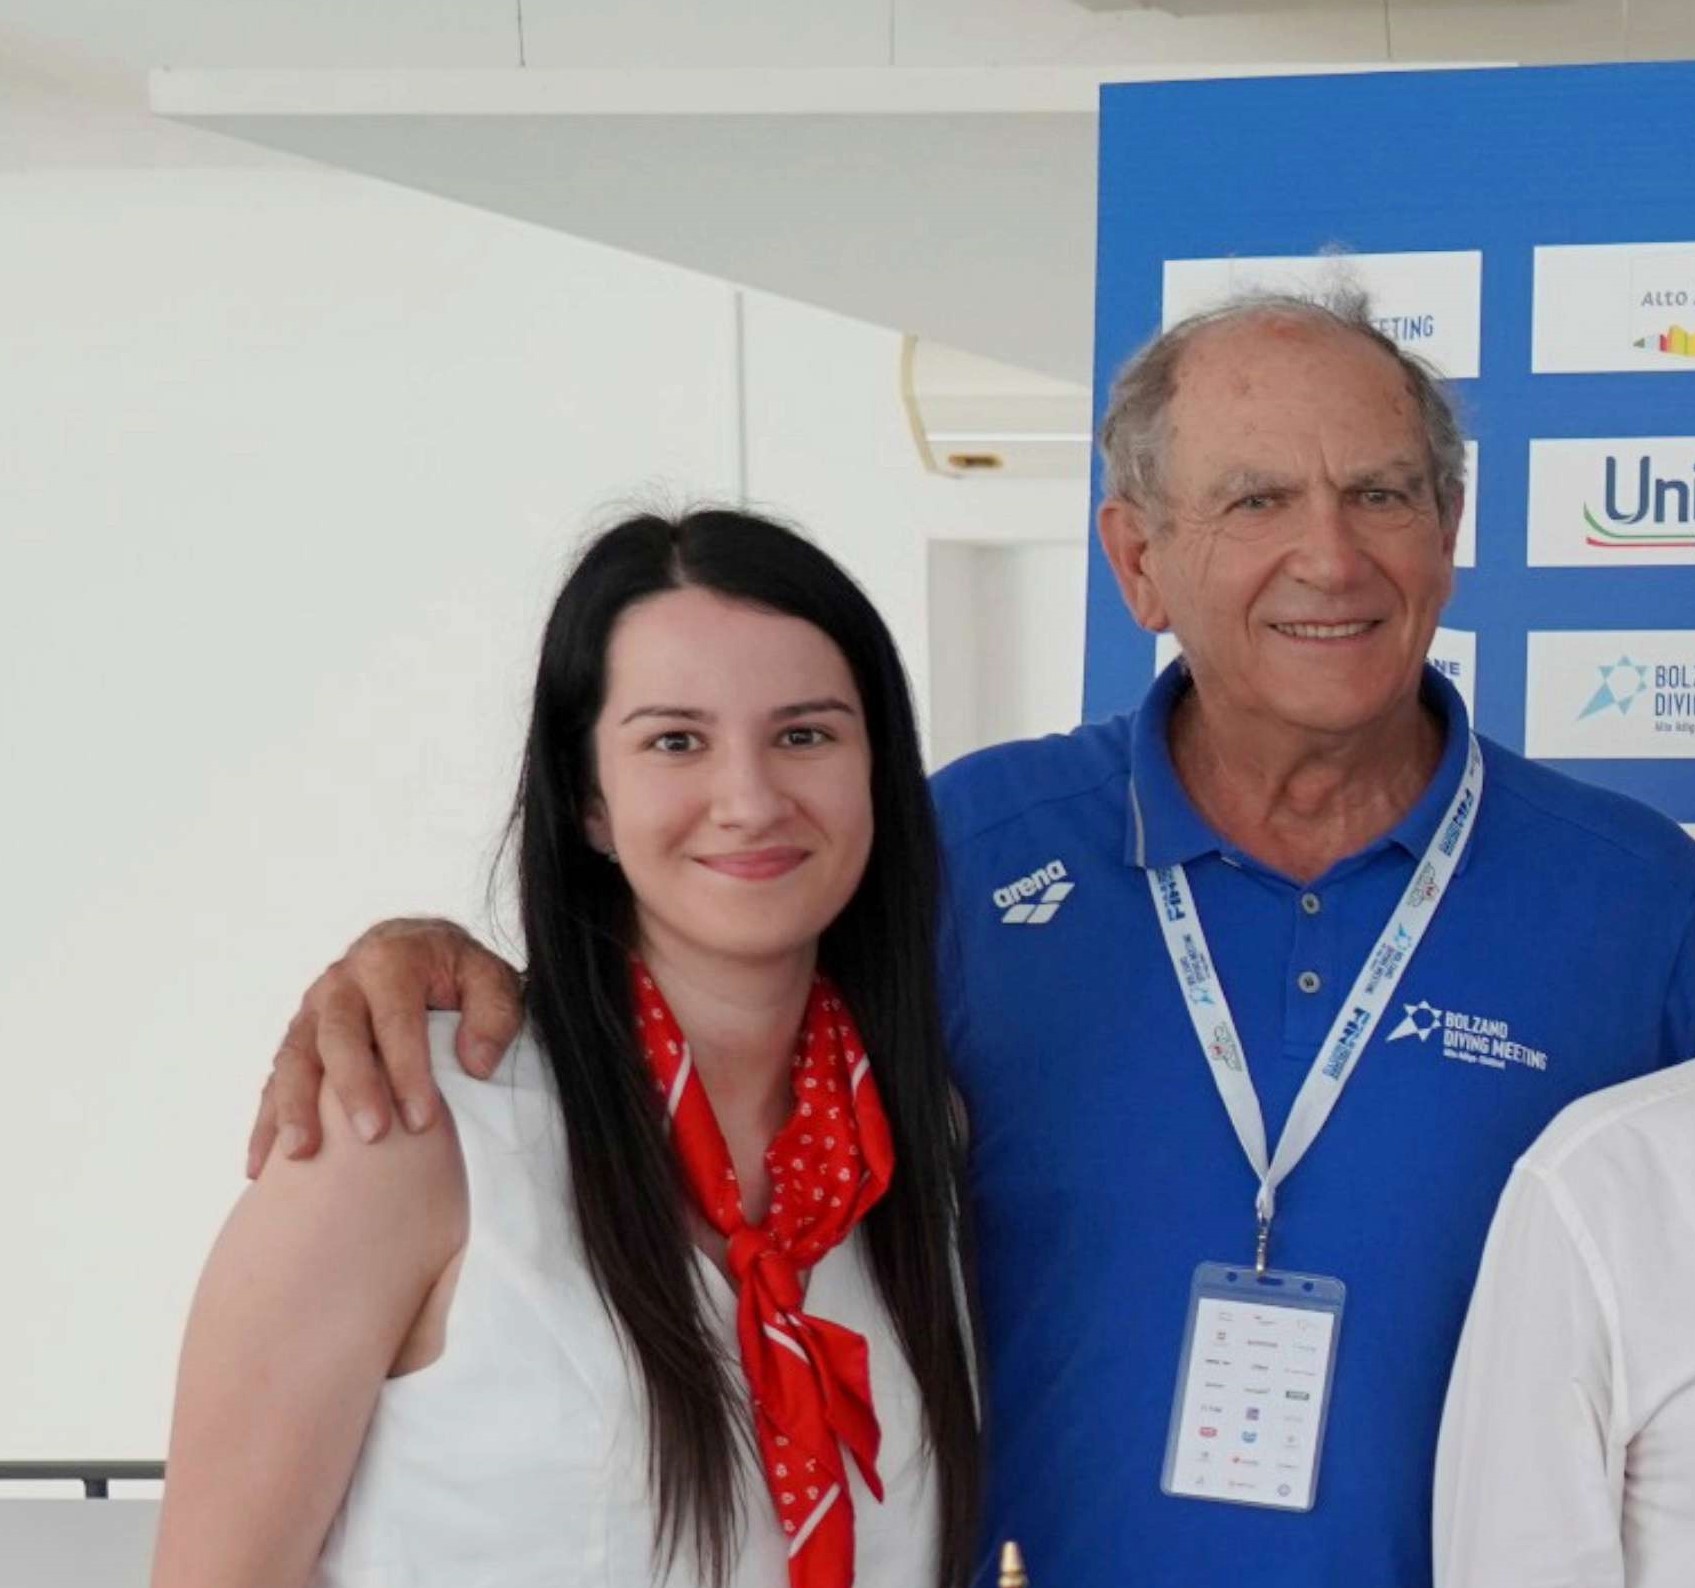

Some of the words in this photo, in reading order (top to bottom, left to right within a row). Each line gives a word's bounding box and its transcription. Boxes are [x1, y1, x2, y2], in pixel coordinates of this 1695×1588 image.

[993, 859, 1068, 908] arena
[1445, 1010, 1508, 1040] BOLZANO
[1492, 1039, 1548, 1072] MEETING
